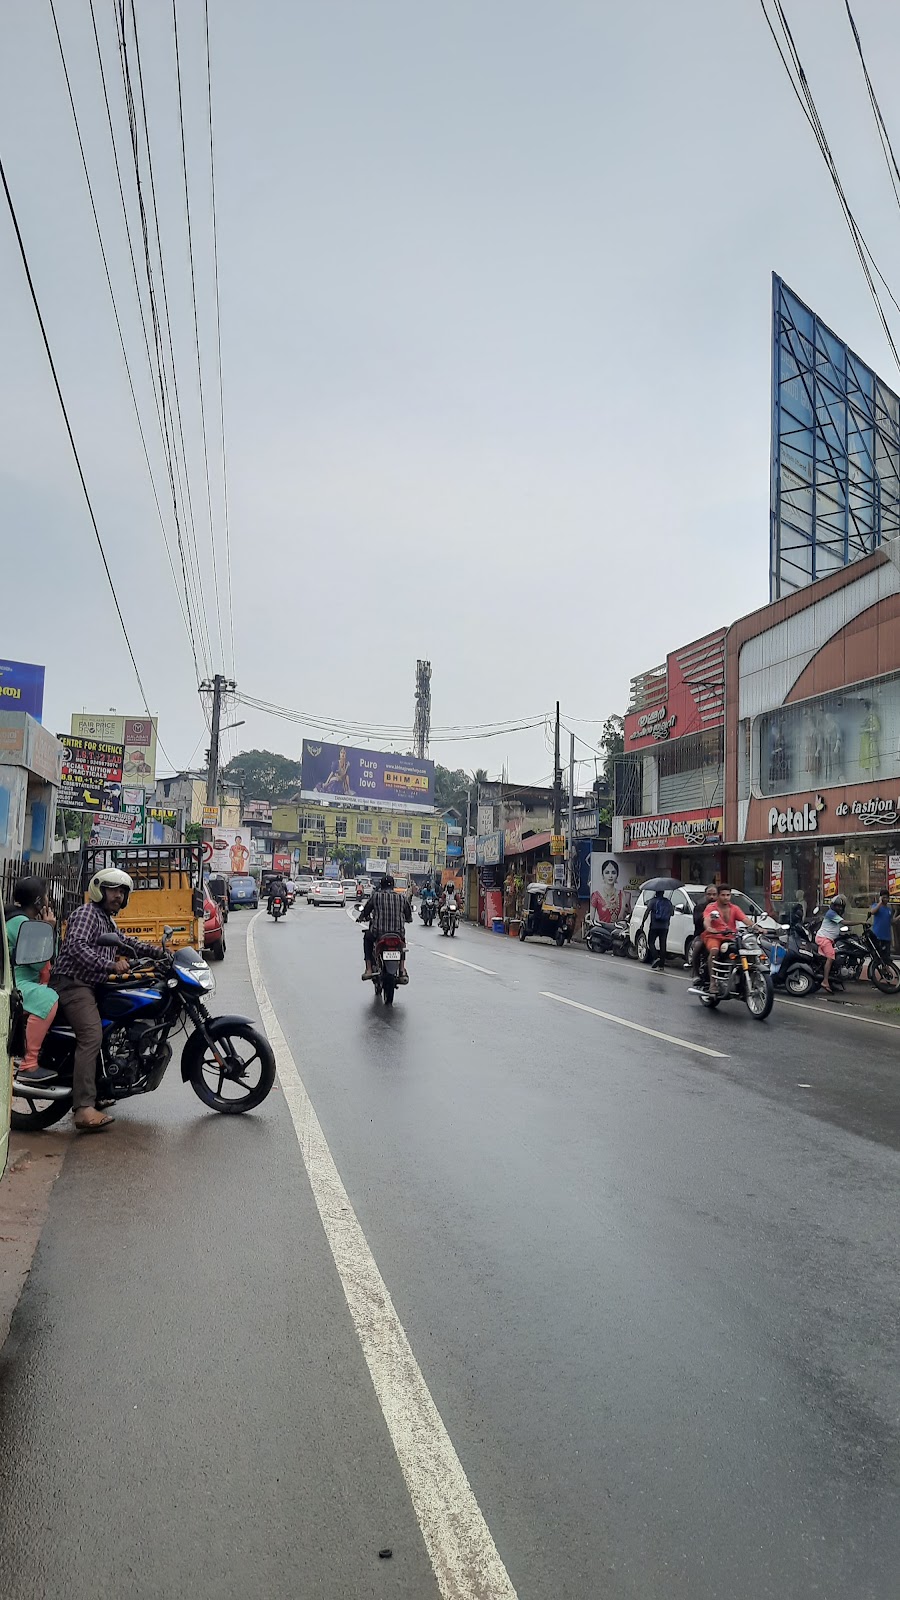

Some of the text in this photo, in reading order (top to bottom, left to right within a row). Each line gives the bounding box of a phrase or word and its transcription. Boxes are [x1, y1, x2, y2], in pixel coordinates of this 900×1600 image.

[84, 741, 97, 751] FOR
[98, 744, 122, 755] SCIENCE
[62, 762, 87, 770] PECIAL
[87, 764, 112, 774] TUITION
[360, 758, 378, 770] Pure
[68, 768, 107, 779] PRACTICALS
[363, 771, 373, 779] as
[386, 773, 420, 785] BHIMA
[359, 777, 376, 788] love
[125, 805, 140, 813] NEO
[836, 802, 848, 816] de
[98, 814, 132, 825] GUIDANCE
[768, 803, 817, 834] Petals
[630, 818, 671, 839] THRISSUR
